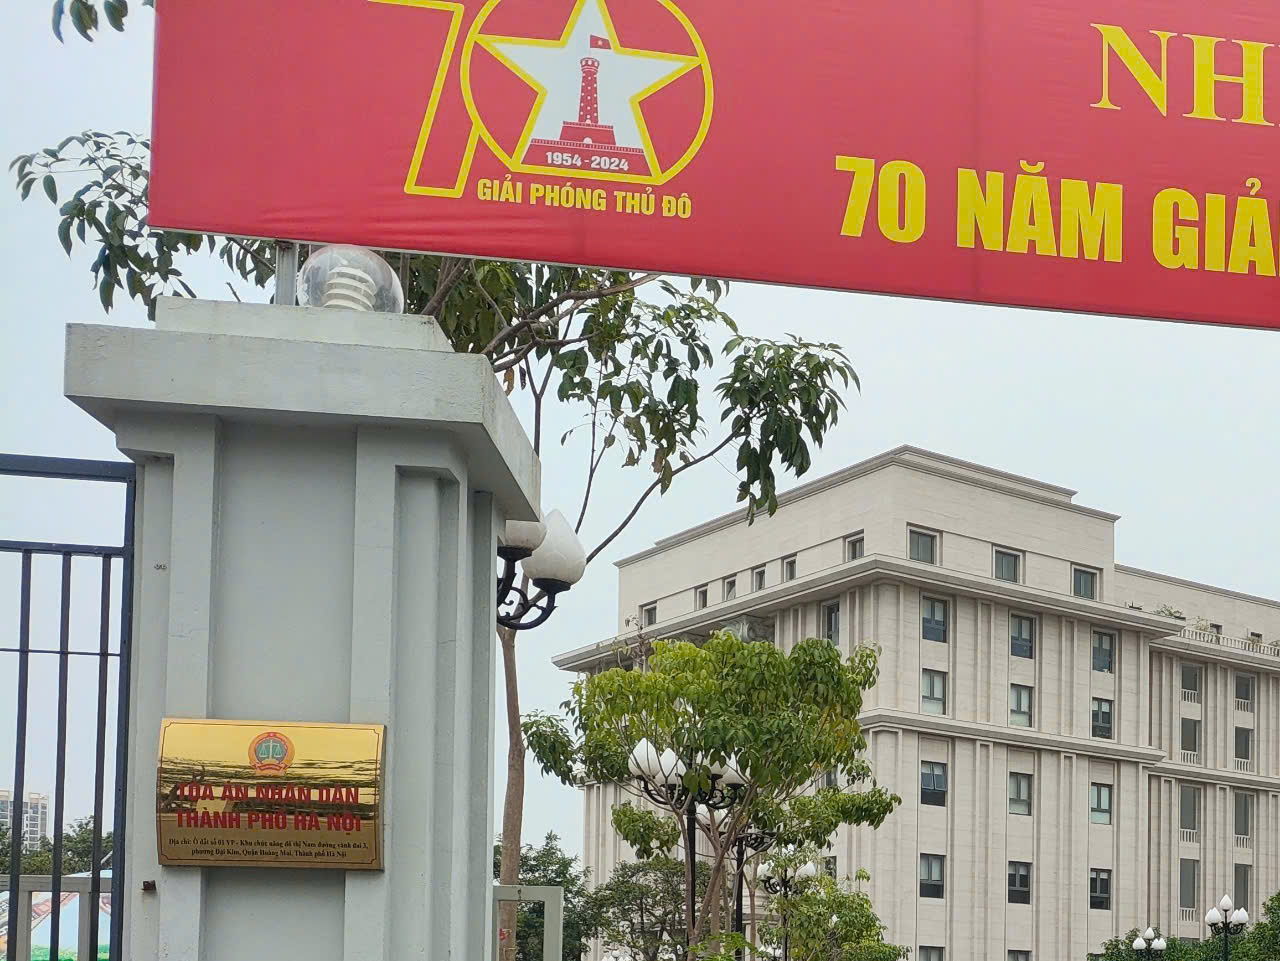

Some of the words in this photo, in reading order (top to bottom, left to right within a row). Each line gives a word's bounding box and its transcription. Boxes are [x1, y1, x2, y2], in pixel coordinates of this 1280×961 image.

[546, 152, 582, 167] 1954
[591, 156, 629, 171] 2024
[477, 174, 523, 203] GIẢI
[529, 182, 607, 211] PHÓNG
[614, 187, 656, 216] THỦ
[661, 193, 692, 218] ĐÔ
[835, 155, 926, 243] 70
[956, 159, 1123, 263] NĂM
[221, 780, 249, 801] ÁN
[177, 807, 241, 828] THÀNH
[327, 812, 361, 836] NỘI
